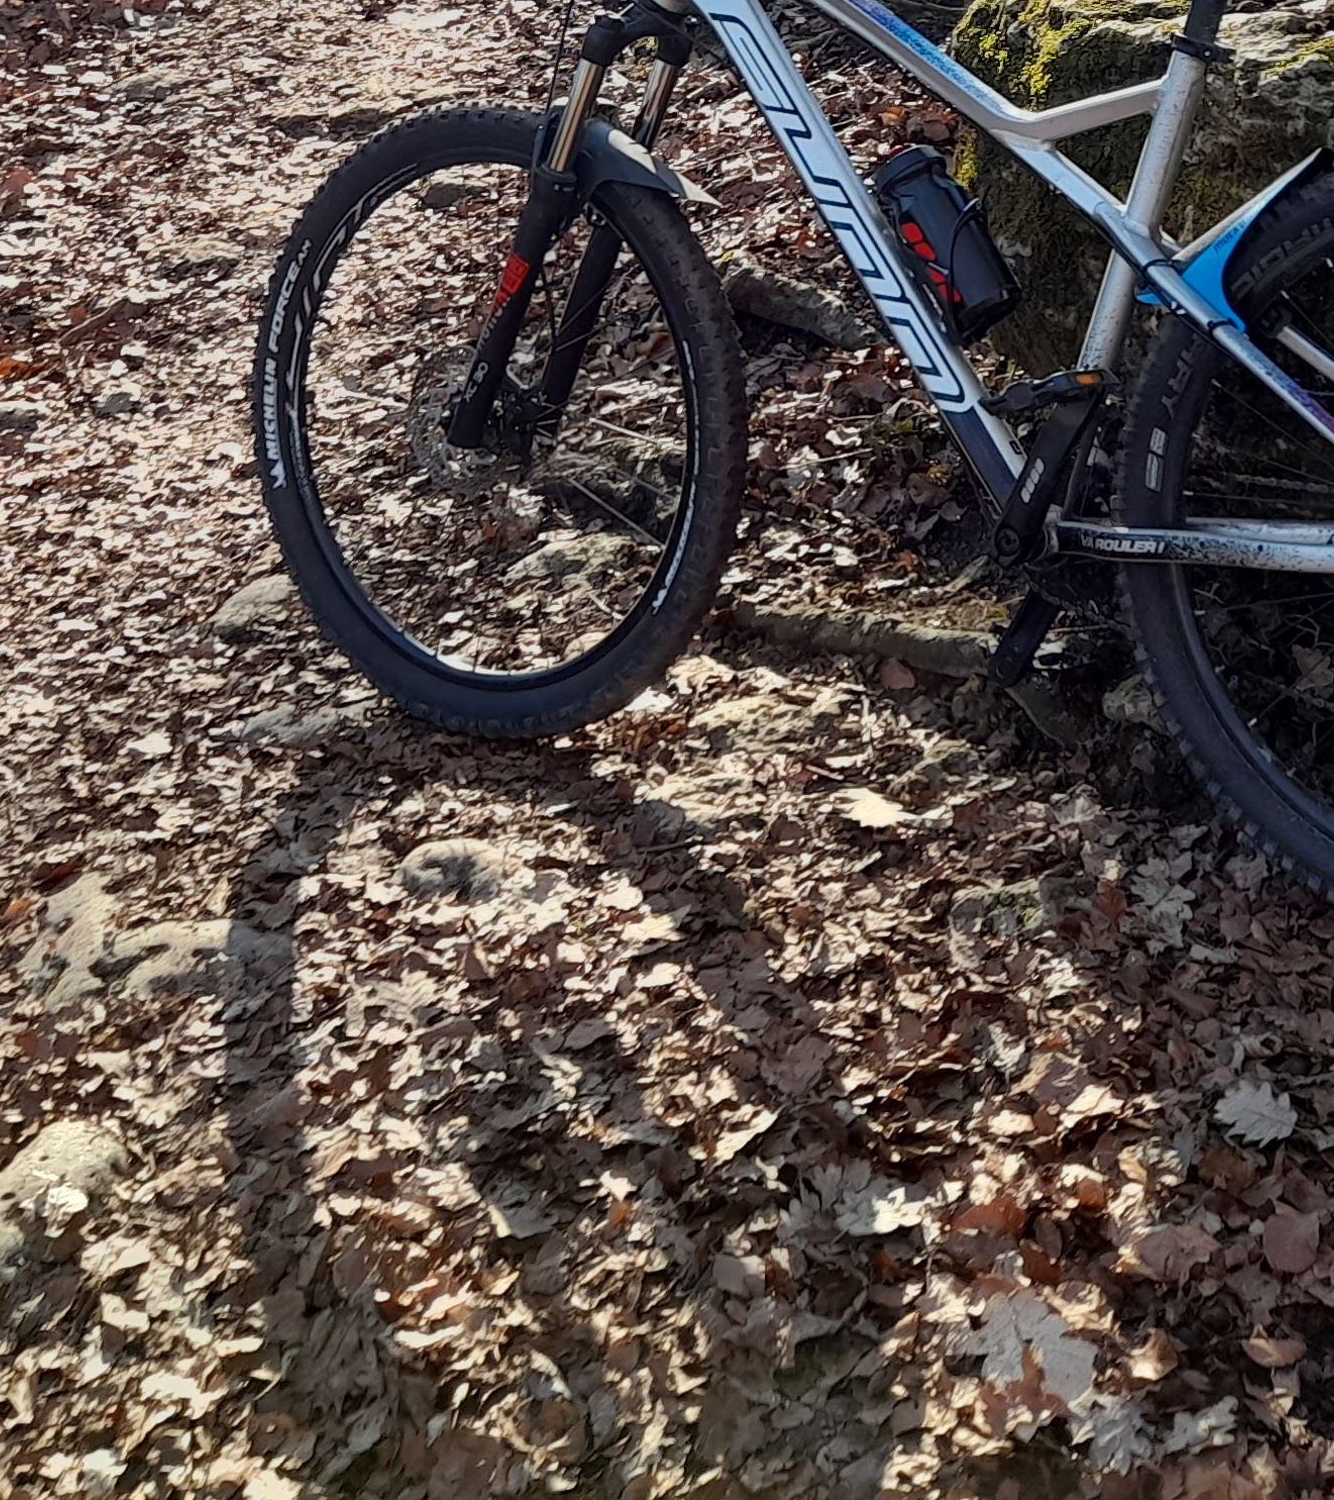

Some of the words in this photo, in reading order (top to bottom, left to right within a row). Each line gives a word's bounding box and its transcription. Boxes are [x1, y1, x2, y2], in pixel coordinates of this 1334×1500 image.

[710, 11, 970, 408] SUNN
[269, 260, 302, 353] FORCE
[263, 357, 283, 460] MICHELIN
